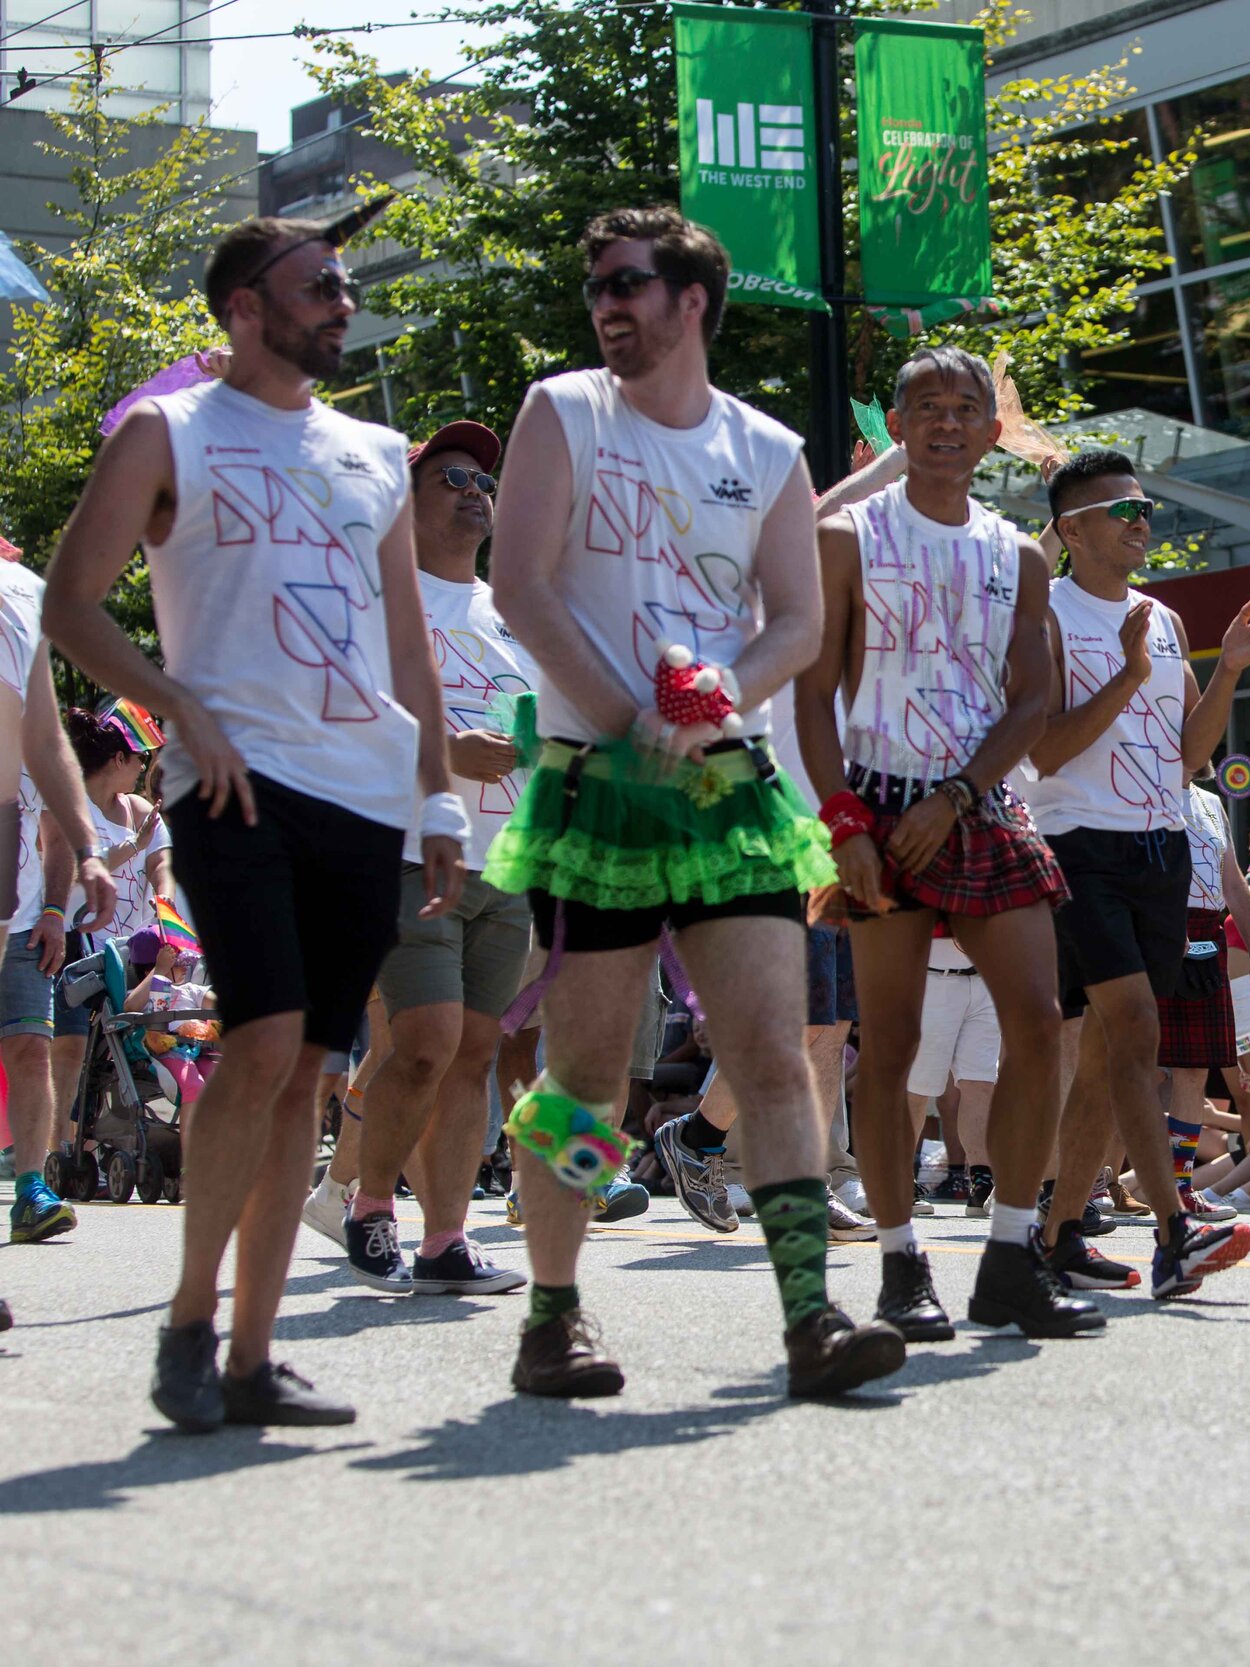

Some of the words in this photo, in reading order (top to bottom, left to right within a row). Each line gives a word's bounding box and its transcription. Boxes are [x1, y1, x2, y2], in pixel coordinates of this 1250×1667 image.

[882, 130, 956, 149] CELEBRATION
[959, 134, 974, 150] OF
[698, 169, 727, 185] THE
[730, 173, 772, 188] WEST
[775, 175, 806, 189] END
[872, 141, 978, 216] Light
